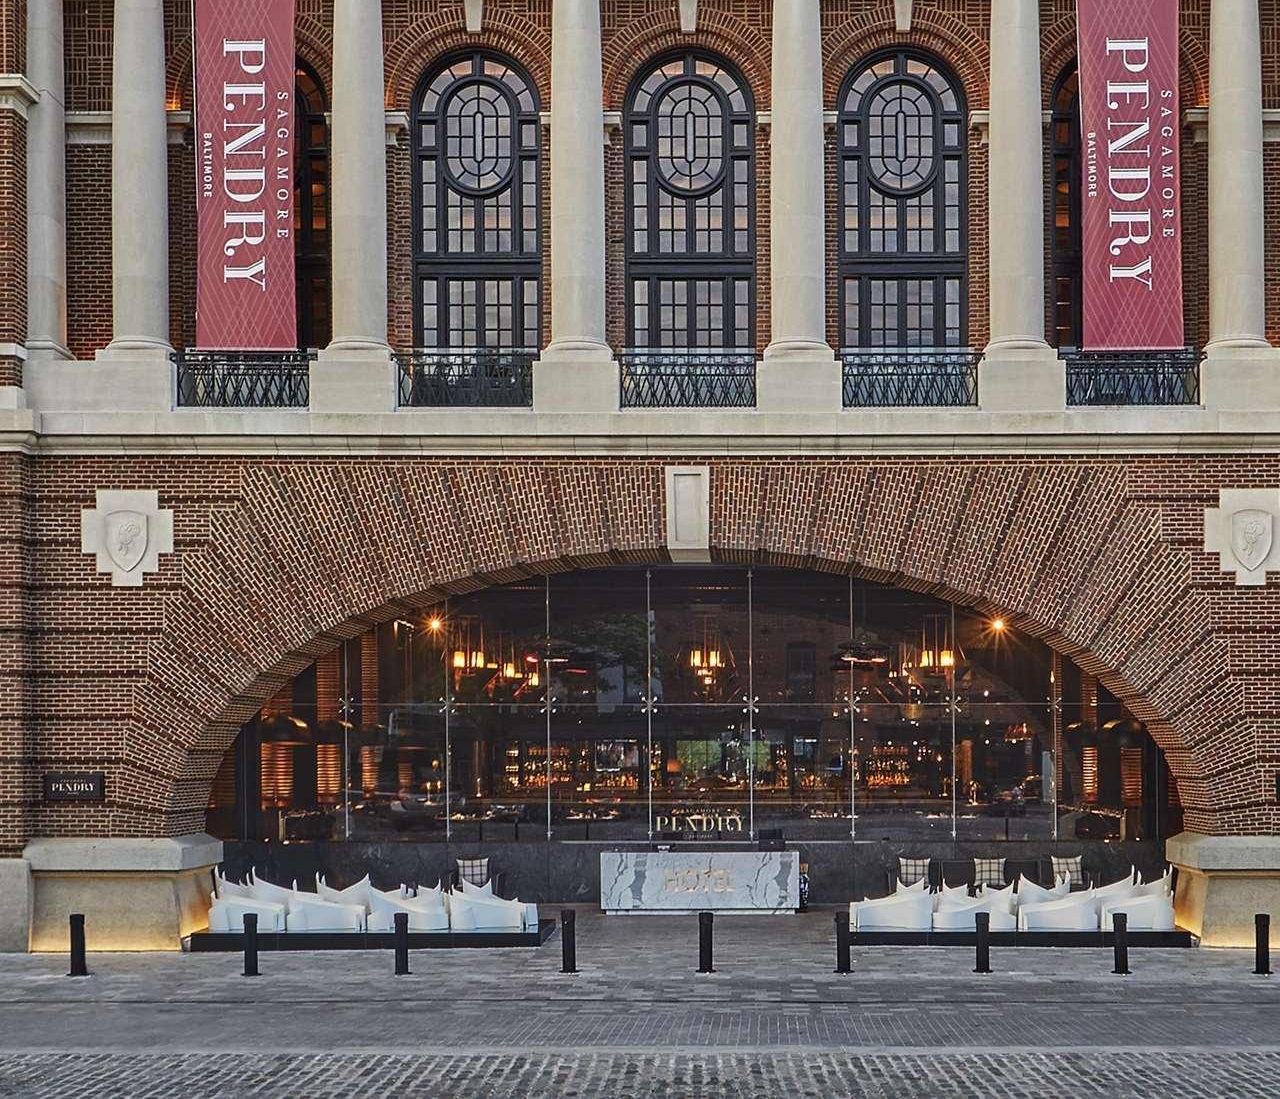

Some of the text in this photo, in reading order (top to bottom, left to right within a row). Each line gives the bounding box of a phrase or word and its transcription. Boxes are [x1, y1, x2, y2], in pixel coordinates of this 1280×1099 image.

[203, 132, 213, 198] BALTIMORE
[223, 38, 266, 292] PENDRY
[277, 91, 289, 239] SAGAMORE
[1087, 132, 1098, 198] BALTIMORE
[1106, 37, 1153, 291] PENDRY
[1160, 89, 1175, 239] SAGAMORE
[51, 783, 95, 791] PENDRY
[656, 816, 745, 831] PENDRY
[663, 869, 737, 893] HOTEL
